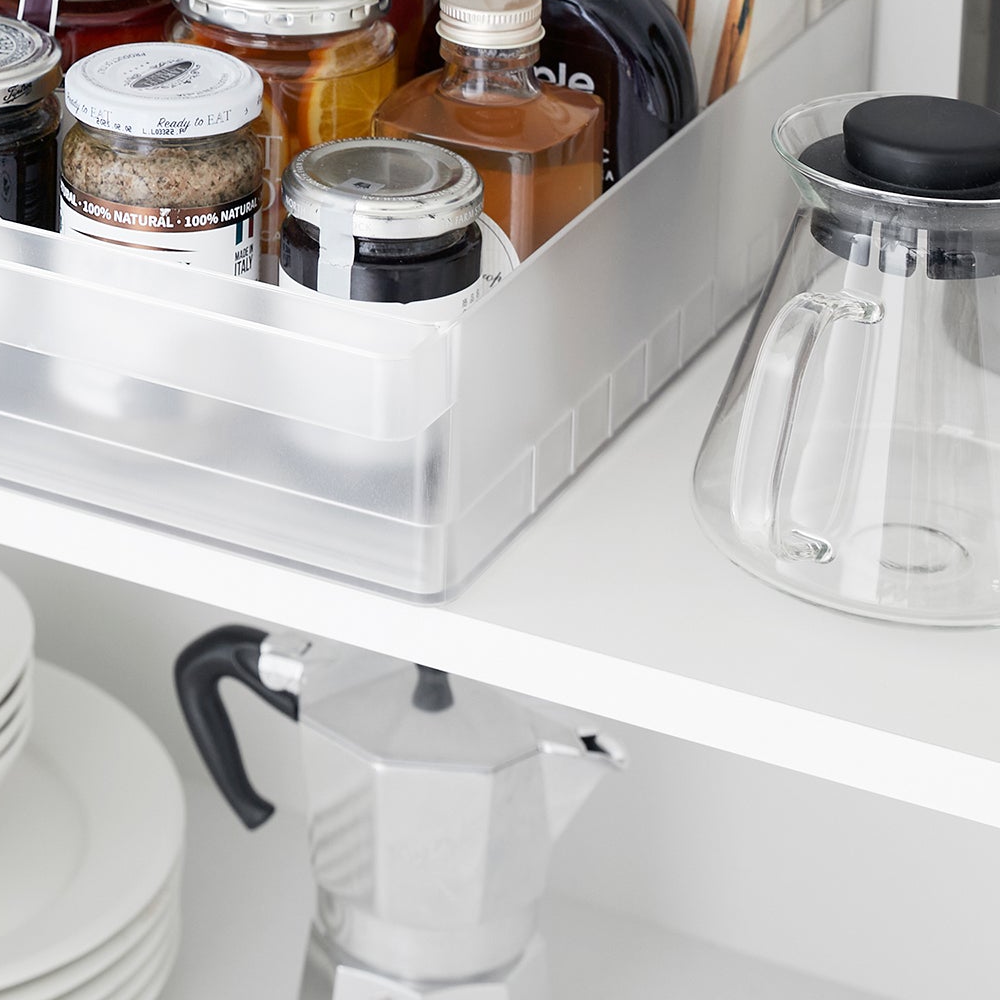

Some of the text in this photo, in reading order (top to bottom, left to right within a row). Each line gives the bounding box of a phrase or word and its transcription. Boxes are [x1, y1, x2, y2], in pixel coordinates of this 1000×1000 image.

[157, 109, 232, 133] Ready to EAT
[82, 200, 112, 221] 100%
[114, 211, 174, 228] NATURAL
[184, 210, 219, 228] 100%
[221, 197, 258, 223] NATURAL
[234, 243, 254, 261] MADE IN
[234, 254, 254, 277] ITALY
